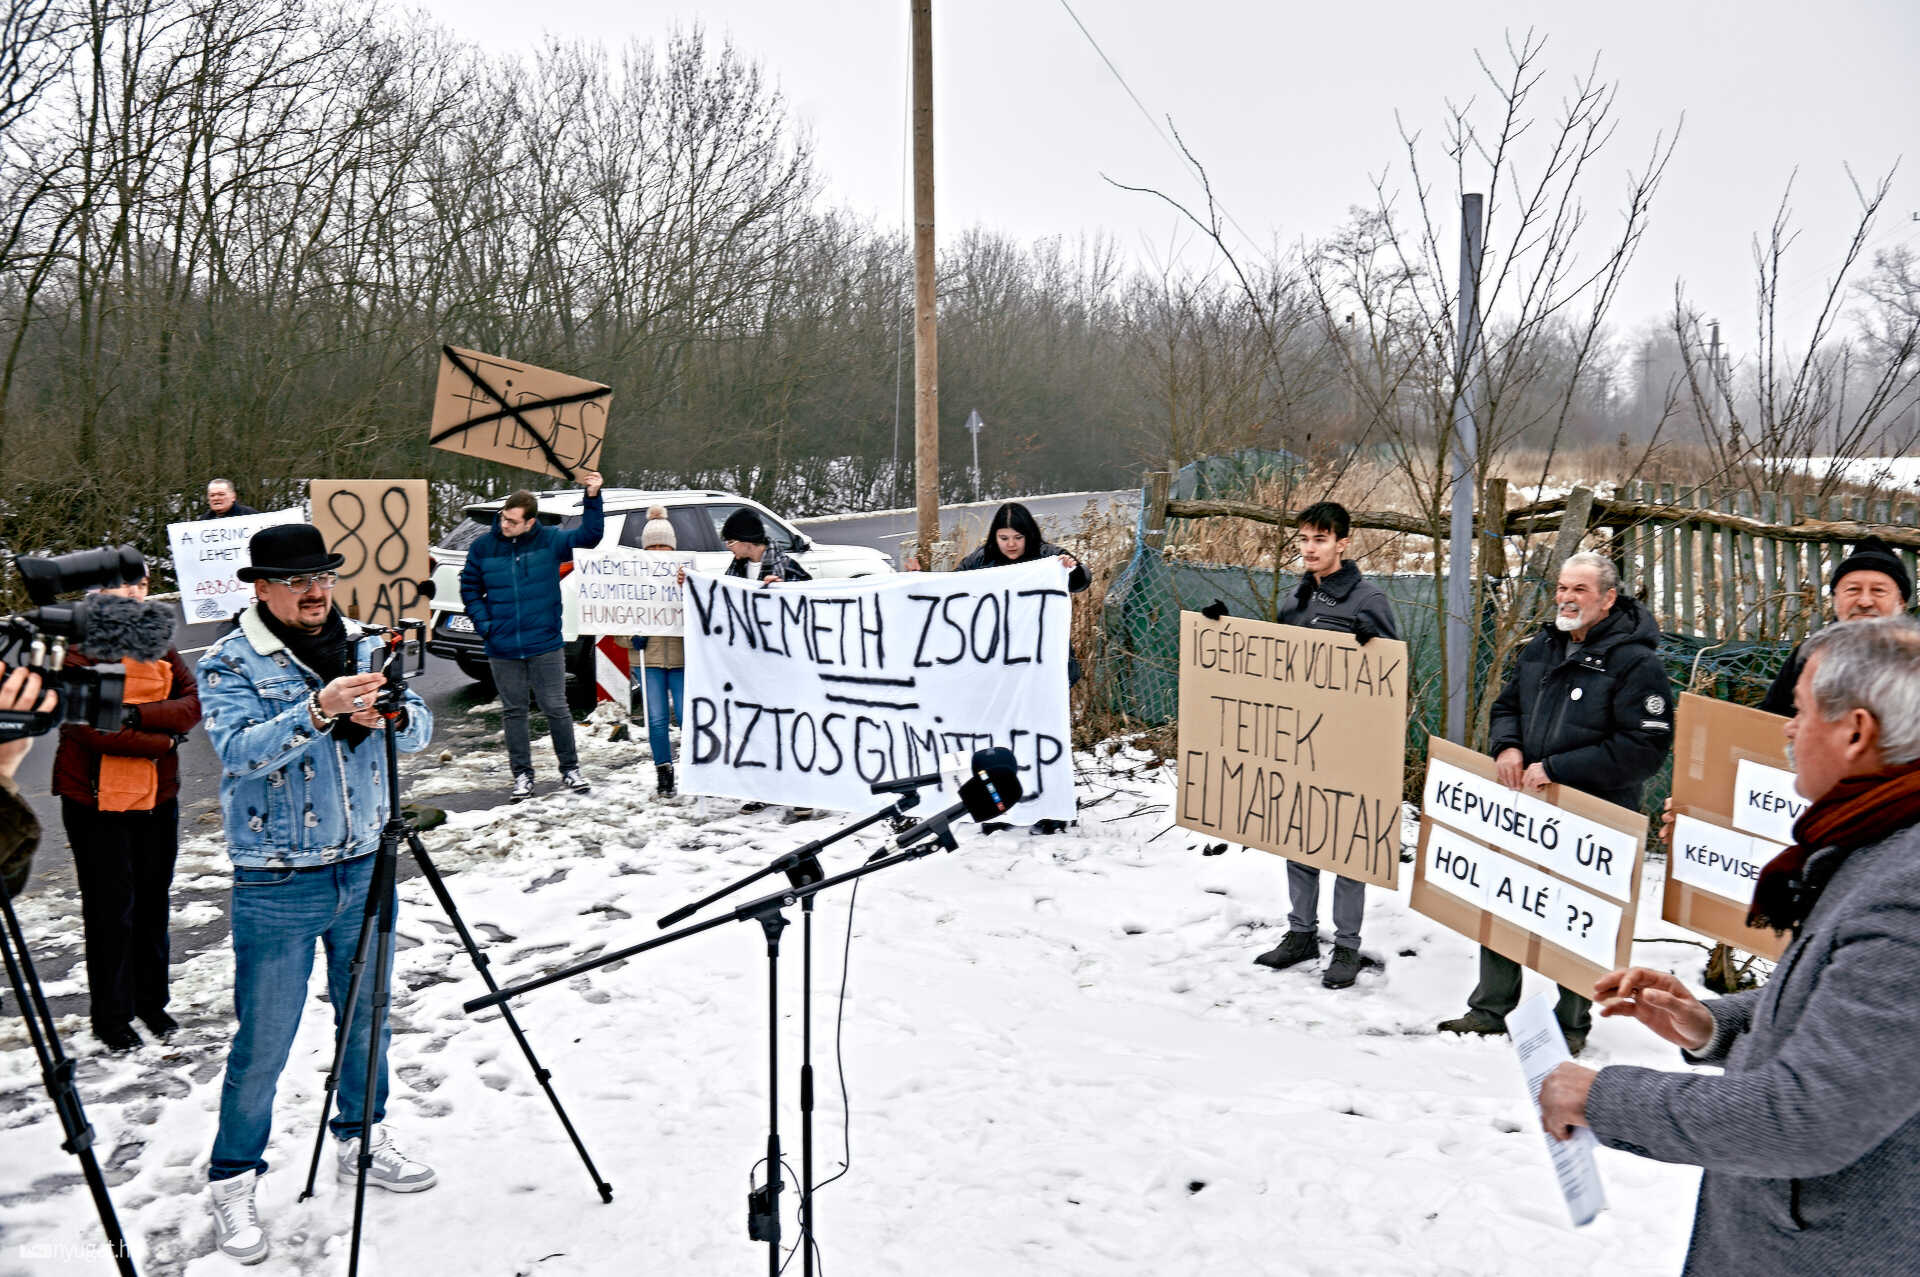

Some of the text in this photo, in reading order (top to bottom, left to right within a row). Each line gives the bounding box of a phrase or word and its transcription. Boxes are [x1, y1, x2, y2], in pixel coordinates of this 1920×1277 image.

[181, 531, 194, 545] A
[199, 547, 241, 562] LEHET
[328, 486, 410, 579] 88
[907, 588, 1068, 668] ZSOLT
[1304, 639, 1400, 698] VOLTAK
[1210, 695, 1324, 772] TETTEK
[1183, 750, 1400, 881] ELMARADTAK
[1436, 780, 1614, 876] KÉPVISELŐ ÚR
[1748, 789, 1809, 819] KÉPV
[1435, 846, 1594, 938] HOL A LÉ ??
